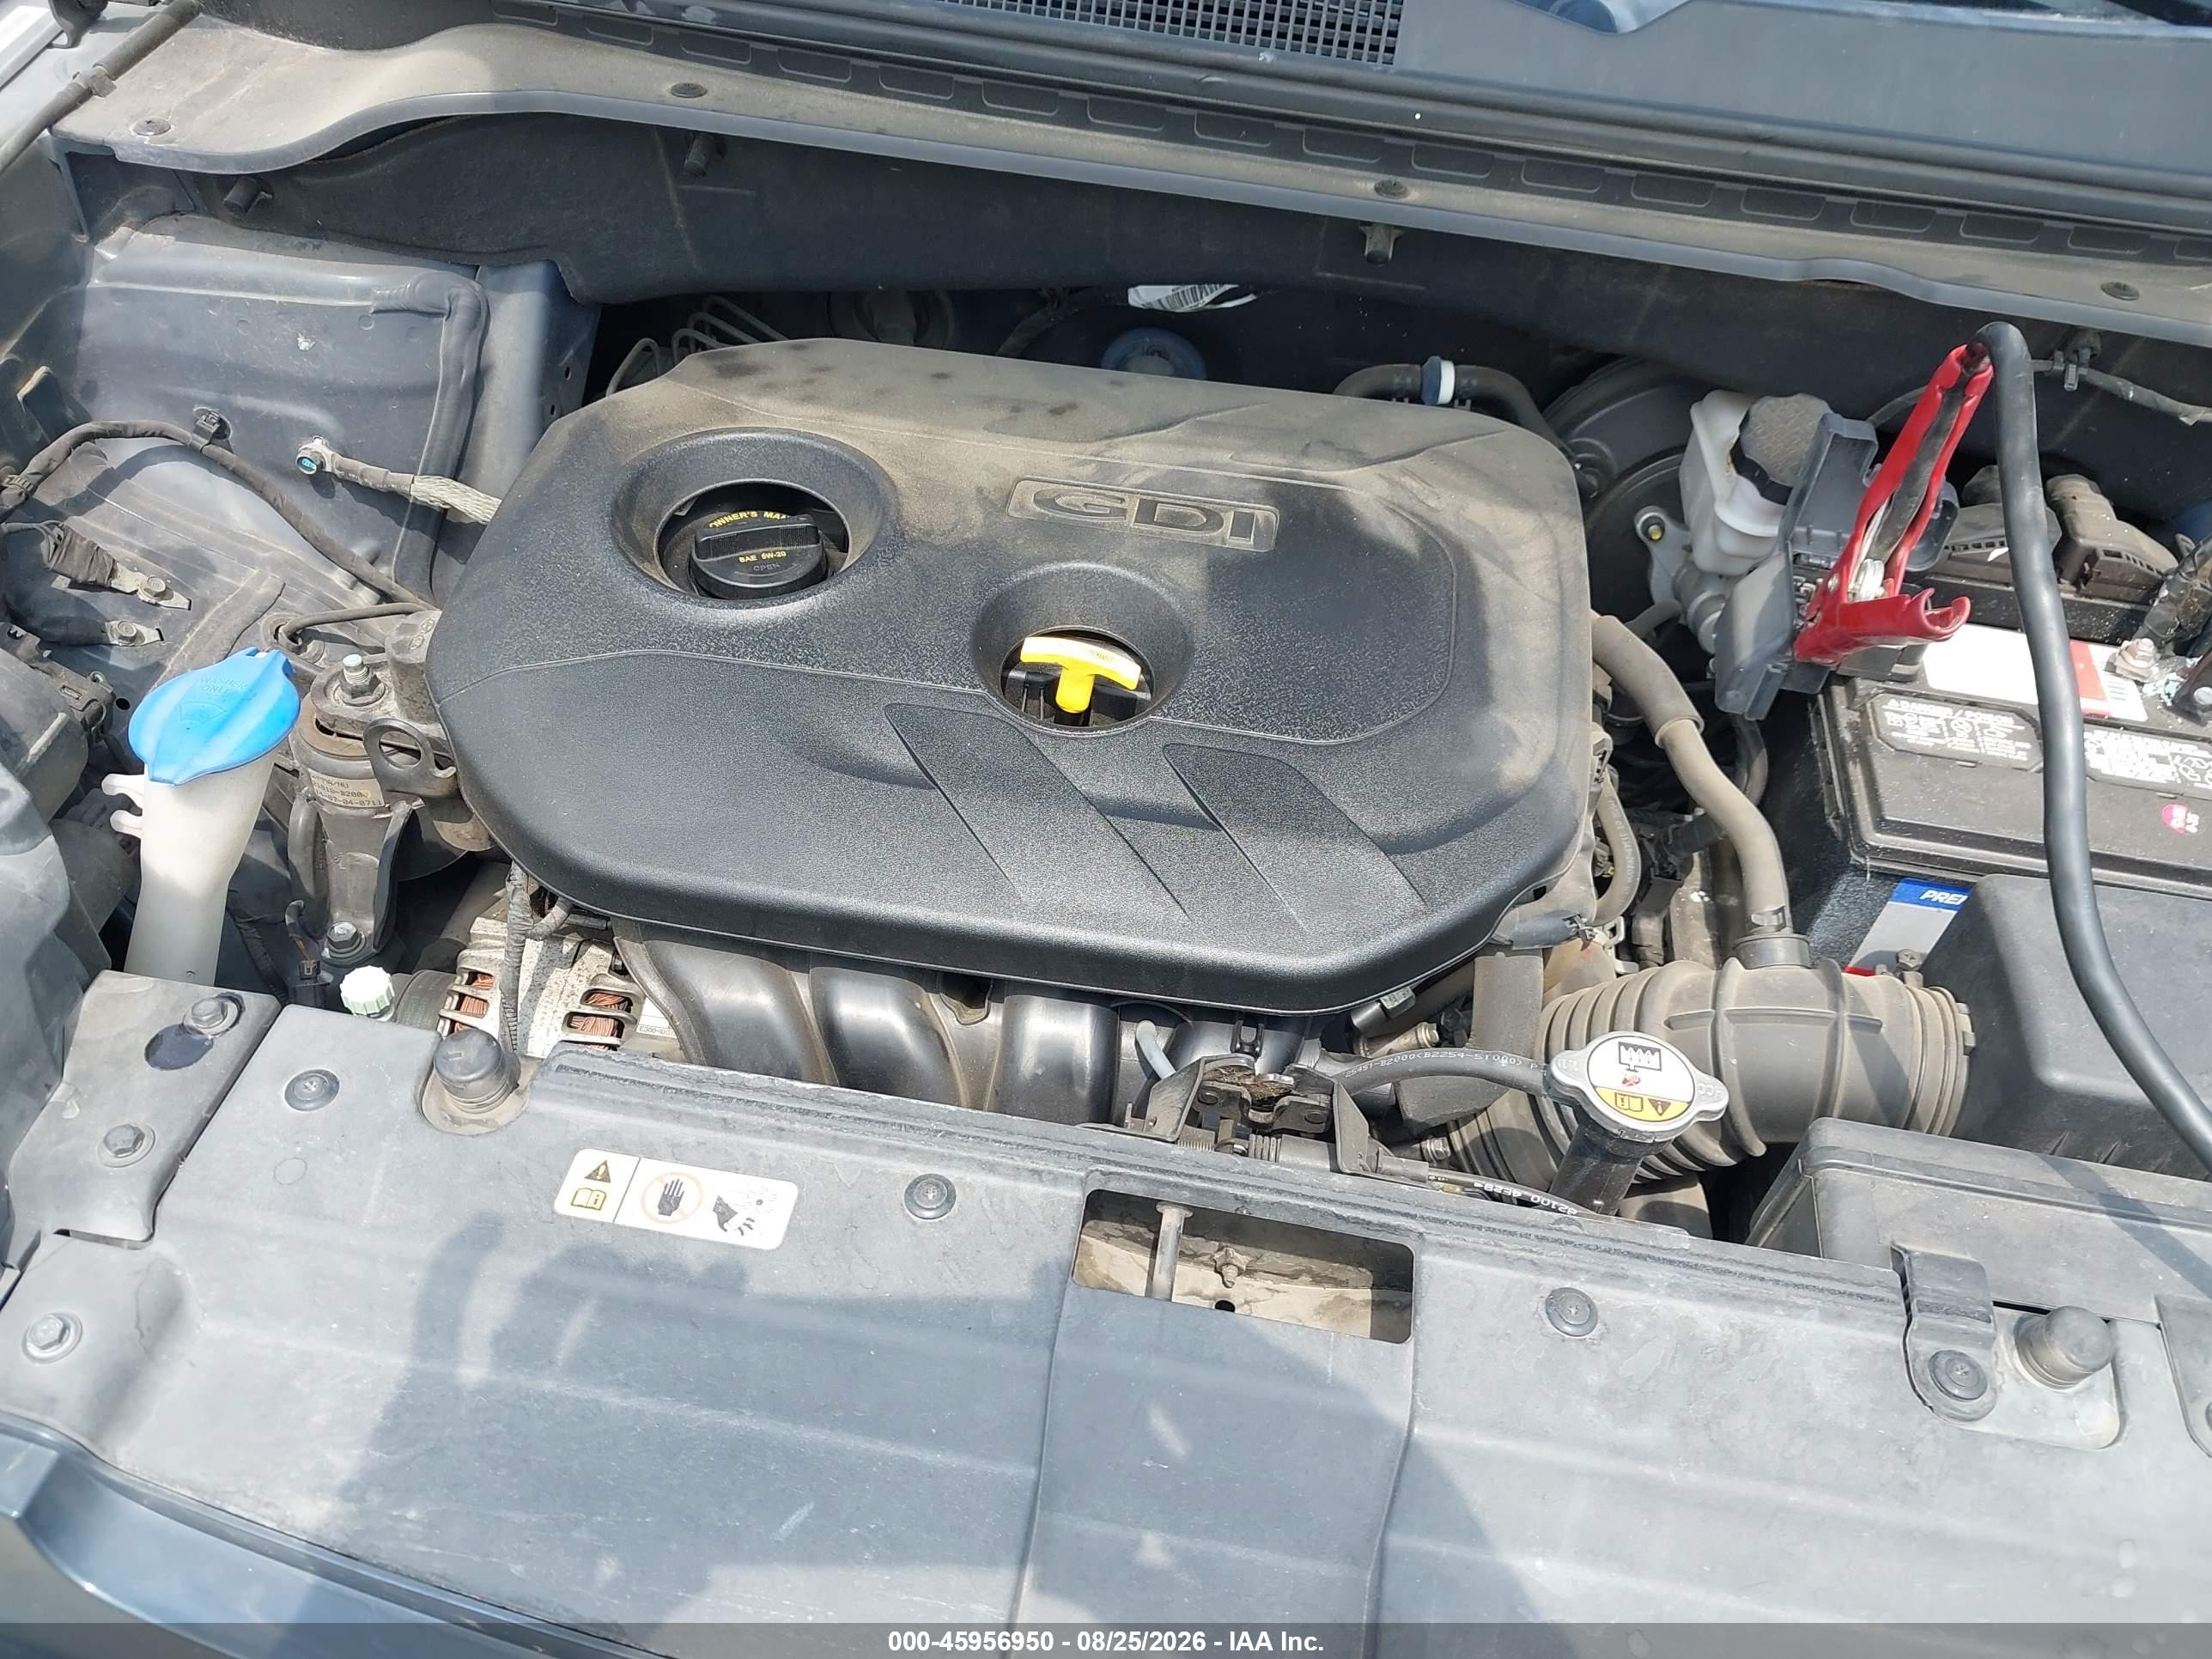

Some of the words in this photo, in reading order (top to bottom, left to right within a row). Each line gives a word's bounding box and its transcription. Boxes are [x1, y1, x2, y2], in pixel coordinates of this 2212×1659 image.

[708, 511, 758, 528] OWNER'S
[1033, 488, 1256, 543] GDI
[753, 563, 781, 572] OPEN
